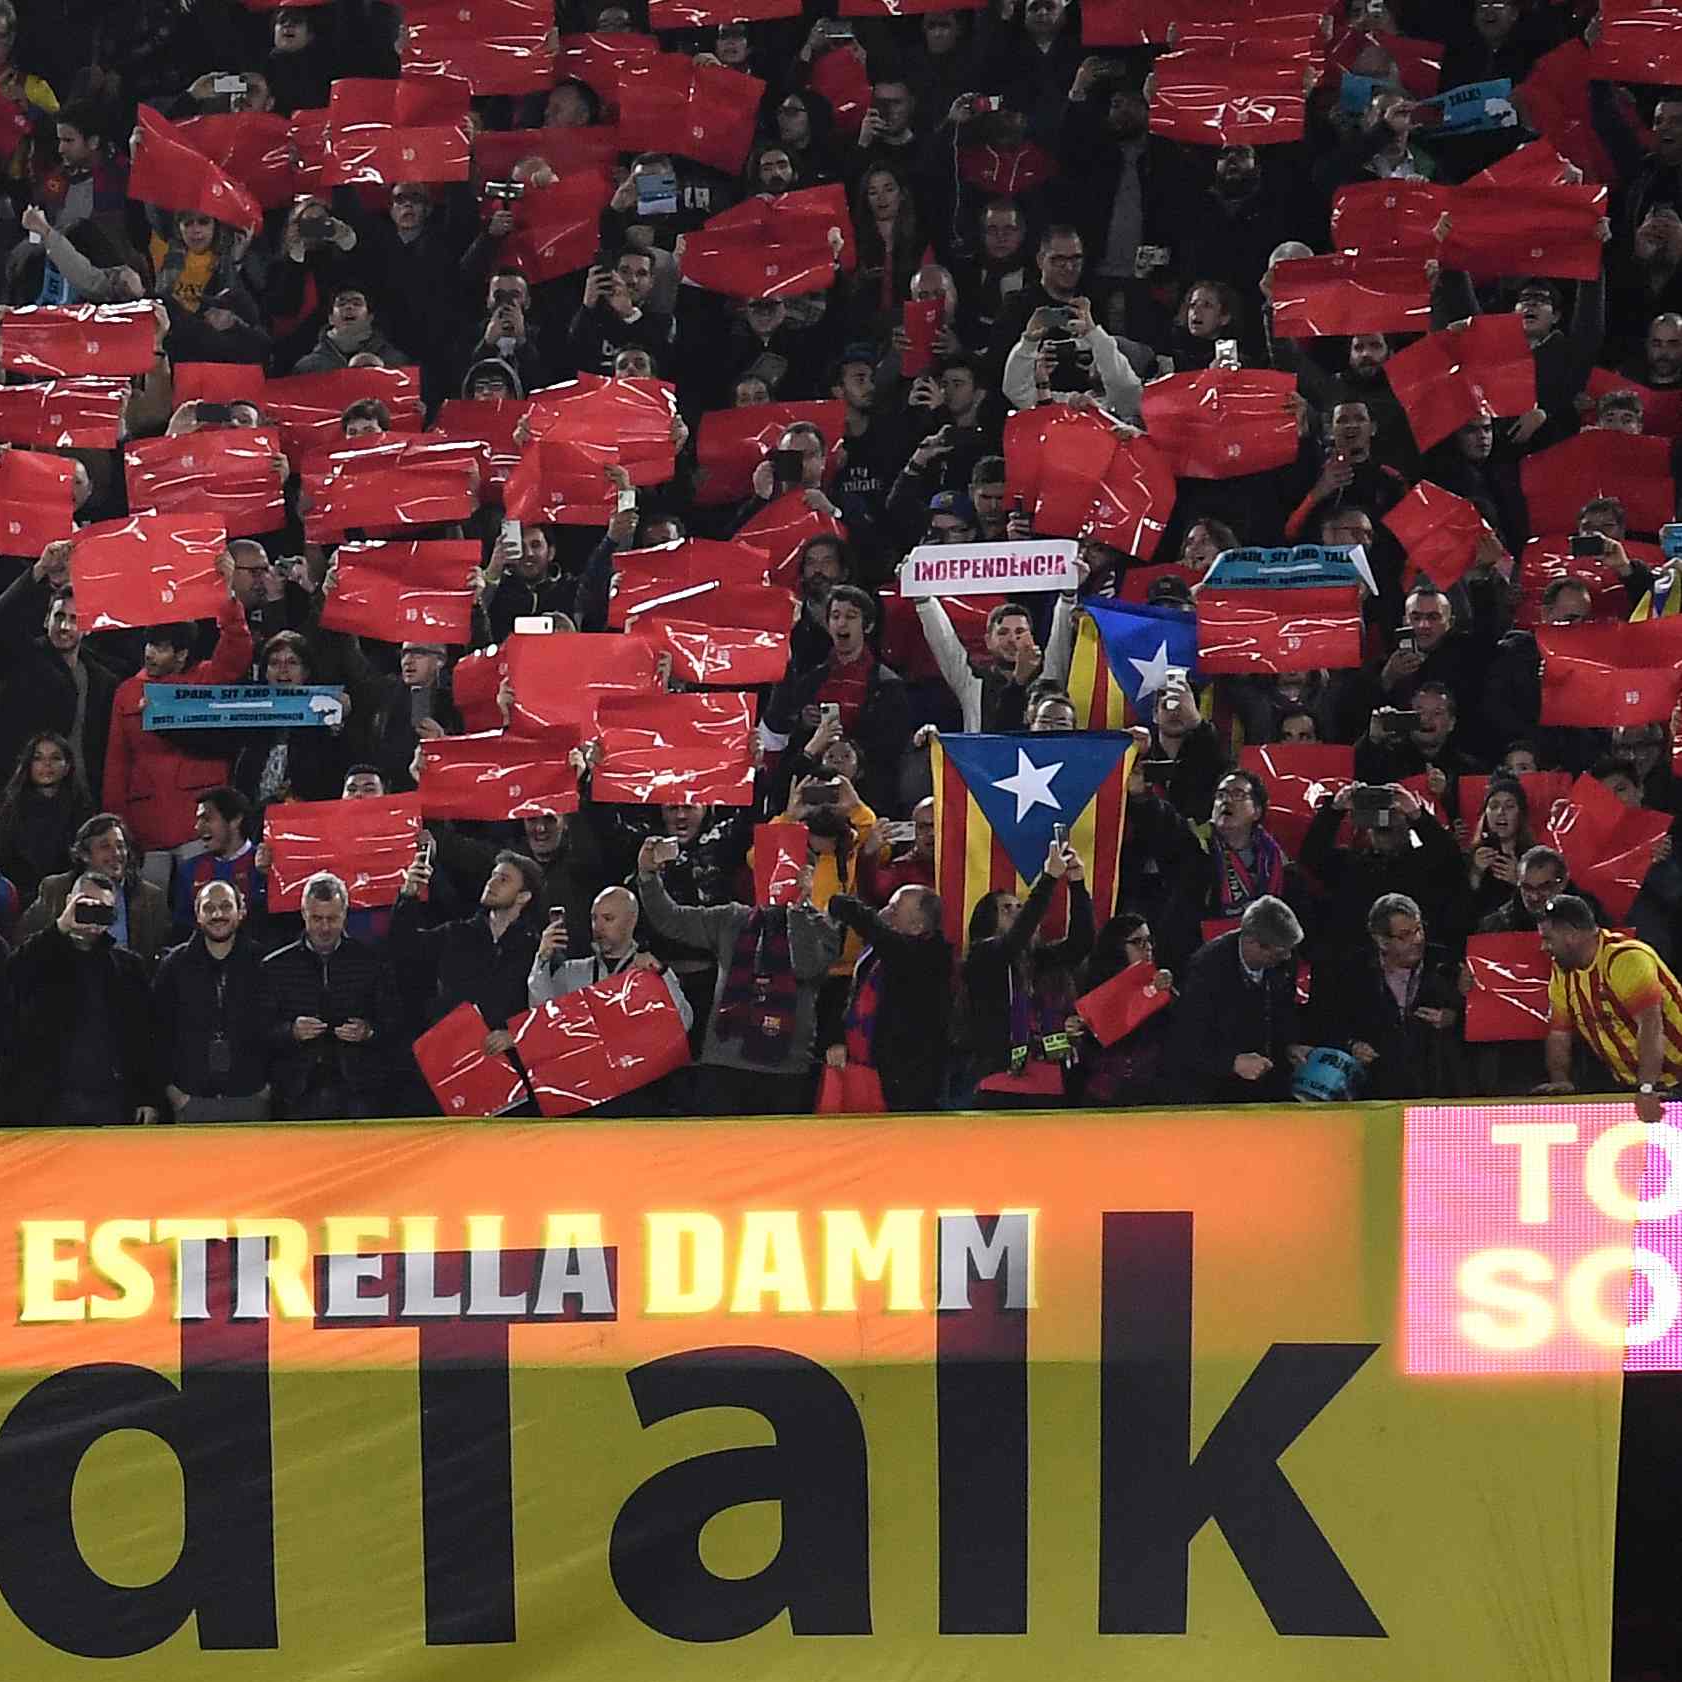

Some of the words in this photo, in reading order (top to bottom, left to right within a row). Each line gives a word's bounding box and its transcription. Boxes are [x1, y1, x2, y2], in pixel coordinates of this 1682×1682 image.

[913, 553, 1068, 582] INDEPENDÈNCIA
[1491, 1121, 1682, 1223] TO
[20, 1211, 616, 1323] ESTRELLA
[640, 1207, 1041, 1315] DAMM
[1457, 1247, 1682, 1350] SO
